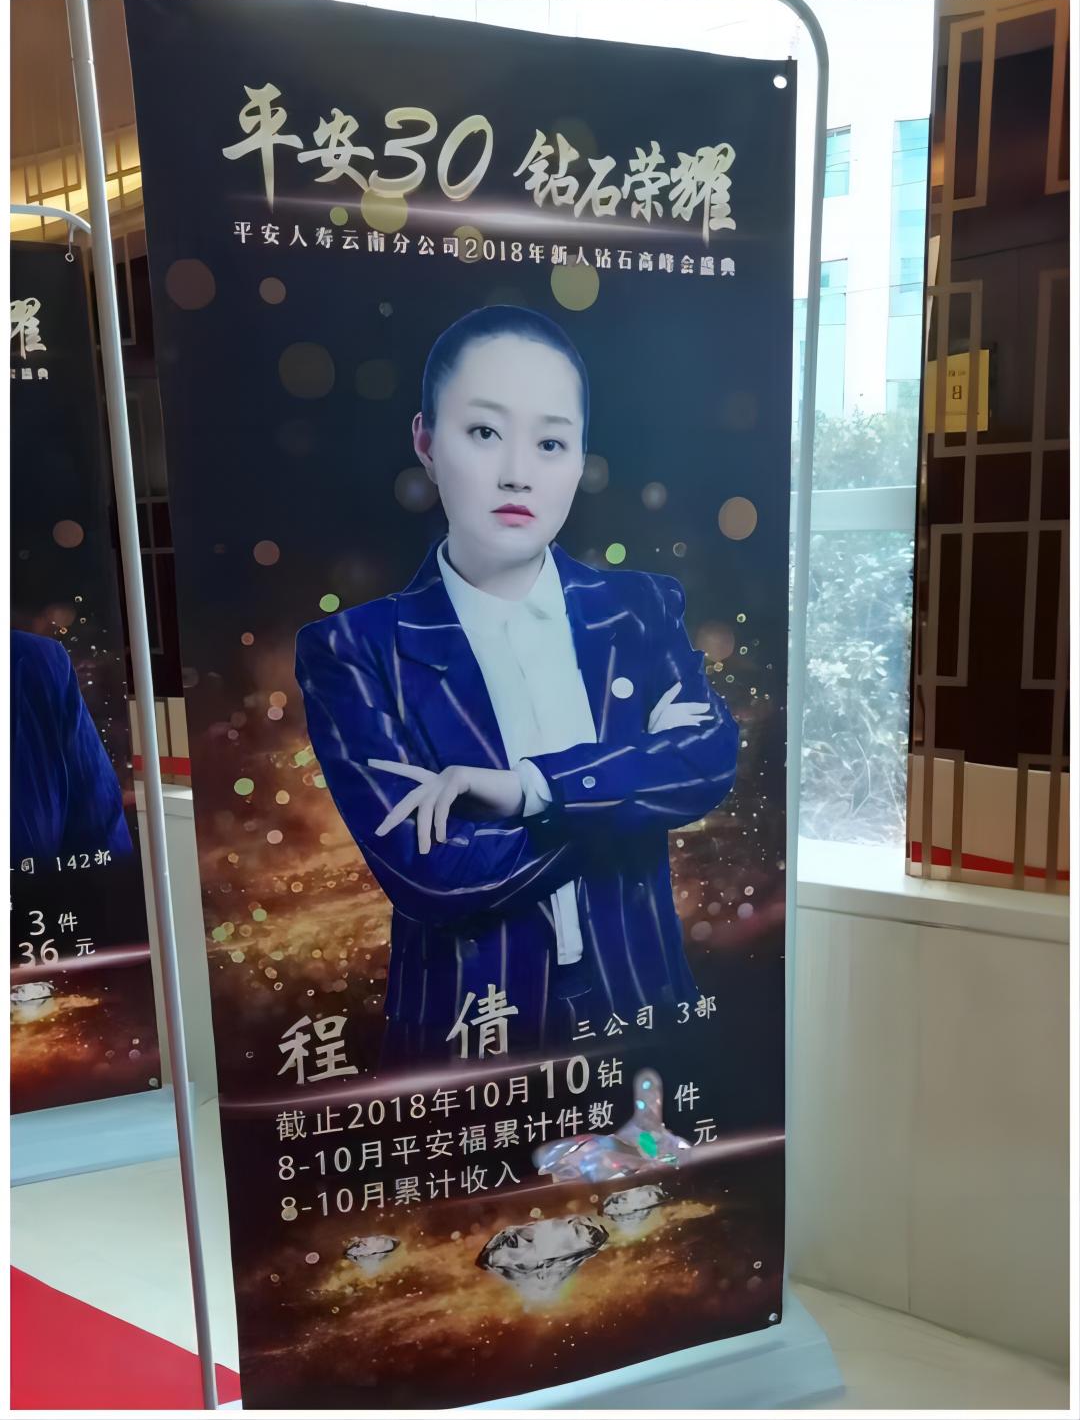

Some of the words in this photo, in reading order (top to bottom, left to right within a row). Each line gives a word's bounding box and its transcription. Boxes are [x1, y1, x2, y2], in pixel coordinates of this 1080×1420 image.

[222, 83, 494, 213] 平安30
[513, 128, 736, 249] 钻石荣耀
[277, 1015, 359, 1085] 程
[445, 983, 519, 1059] 倩
[278, 1100, 614, 1181] 8-10月平安福累计件数
[280, 1160, 521, 1221] 8-10月累计收入
